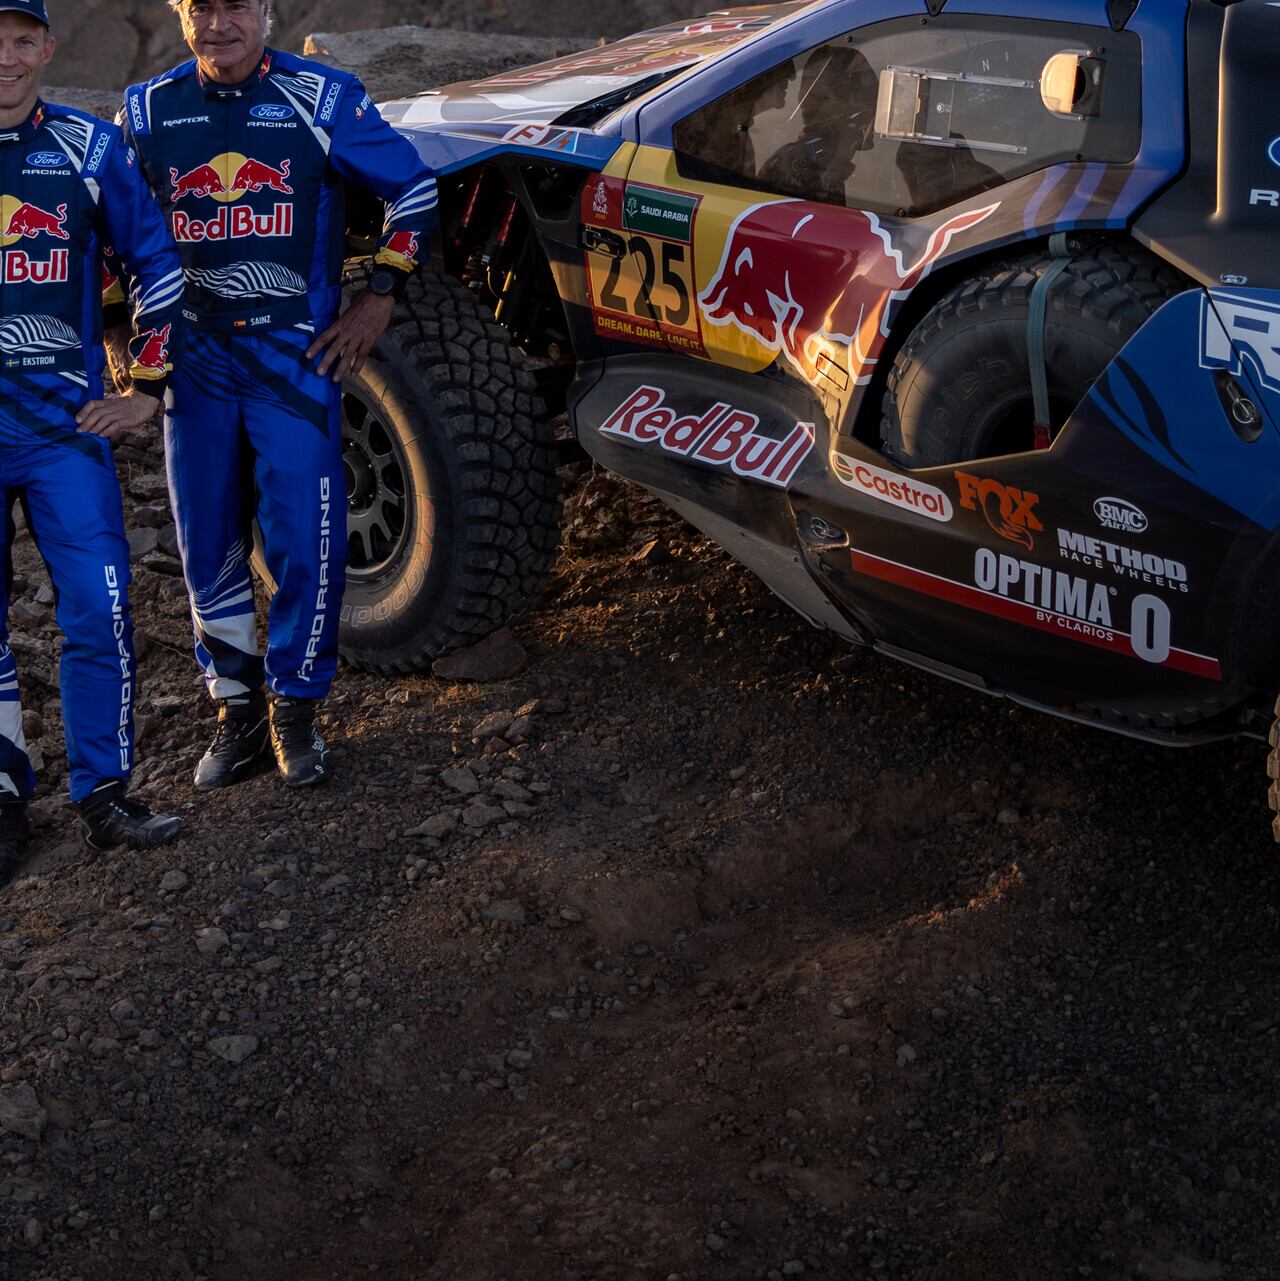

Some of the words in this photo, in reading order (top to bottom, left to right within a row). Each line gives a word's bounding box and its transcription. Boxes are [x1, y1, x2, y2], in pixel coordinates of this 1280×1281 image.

[129, 94, 144, 132] sparco
[163, 115, 213, 128] RAPTOR
[320, 82, 341, 122] sparco
[87, 132, 110, 173] sparco
[172, 206, 228, 243] Red
[230, 202, 293, 239] Bull
[640, 205, 662, 218] SAUDI
[662, 210, 689, 224] ARABIA
[5, 248, 69, 284] Bull
[600, 235, 690, 326] 225
[250, 315, 271, 326] SAINZ
[598, 316, 634, 335] DREAM.
[667, 333, 689, 347] LIVE
[599, 384, 732, 456] Red
[692, 409, 816, 487] Bull
[854, 465, 945, 516] Castrol
[954, 470, 1044, 552] FOX
[1098, 501, 1143, 528] BMC
[316, 476, 330, 610] RACING
[1057, 527, 1188, 582] METHOD
[1059, 549, 1104, 569] RACE
[1113, 565, 1189, 593] WHEELS
[1036, 610, 1053, 623] BY
[1057, 617, 1114, 642] CLARIOS
